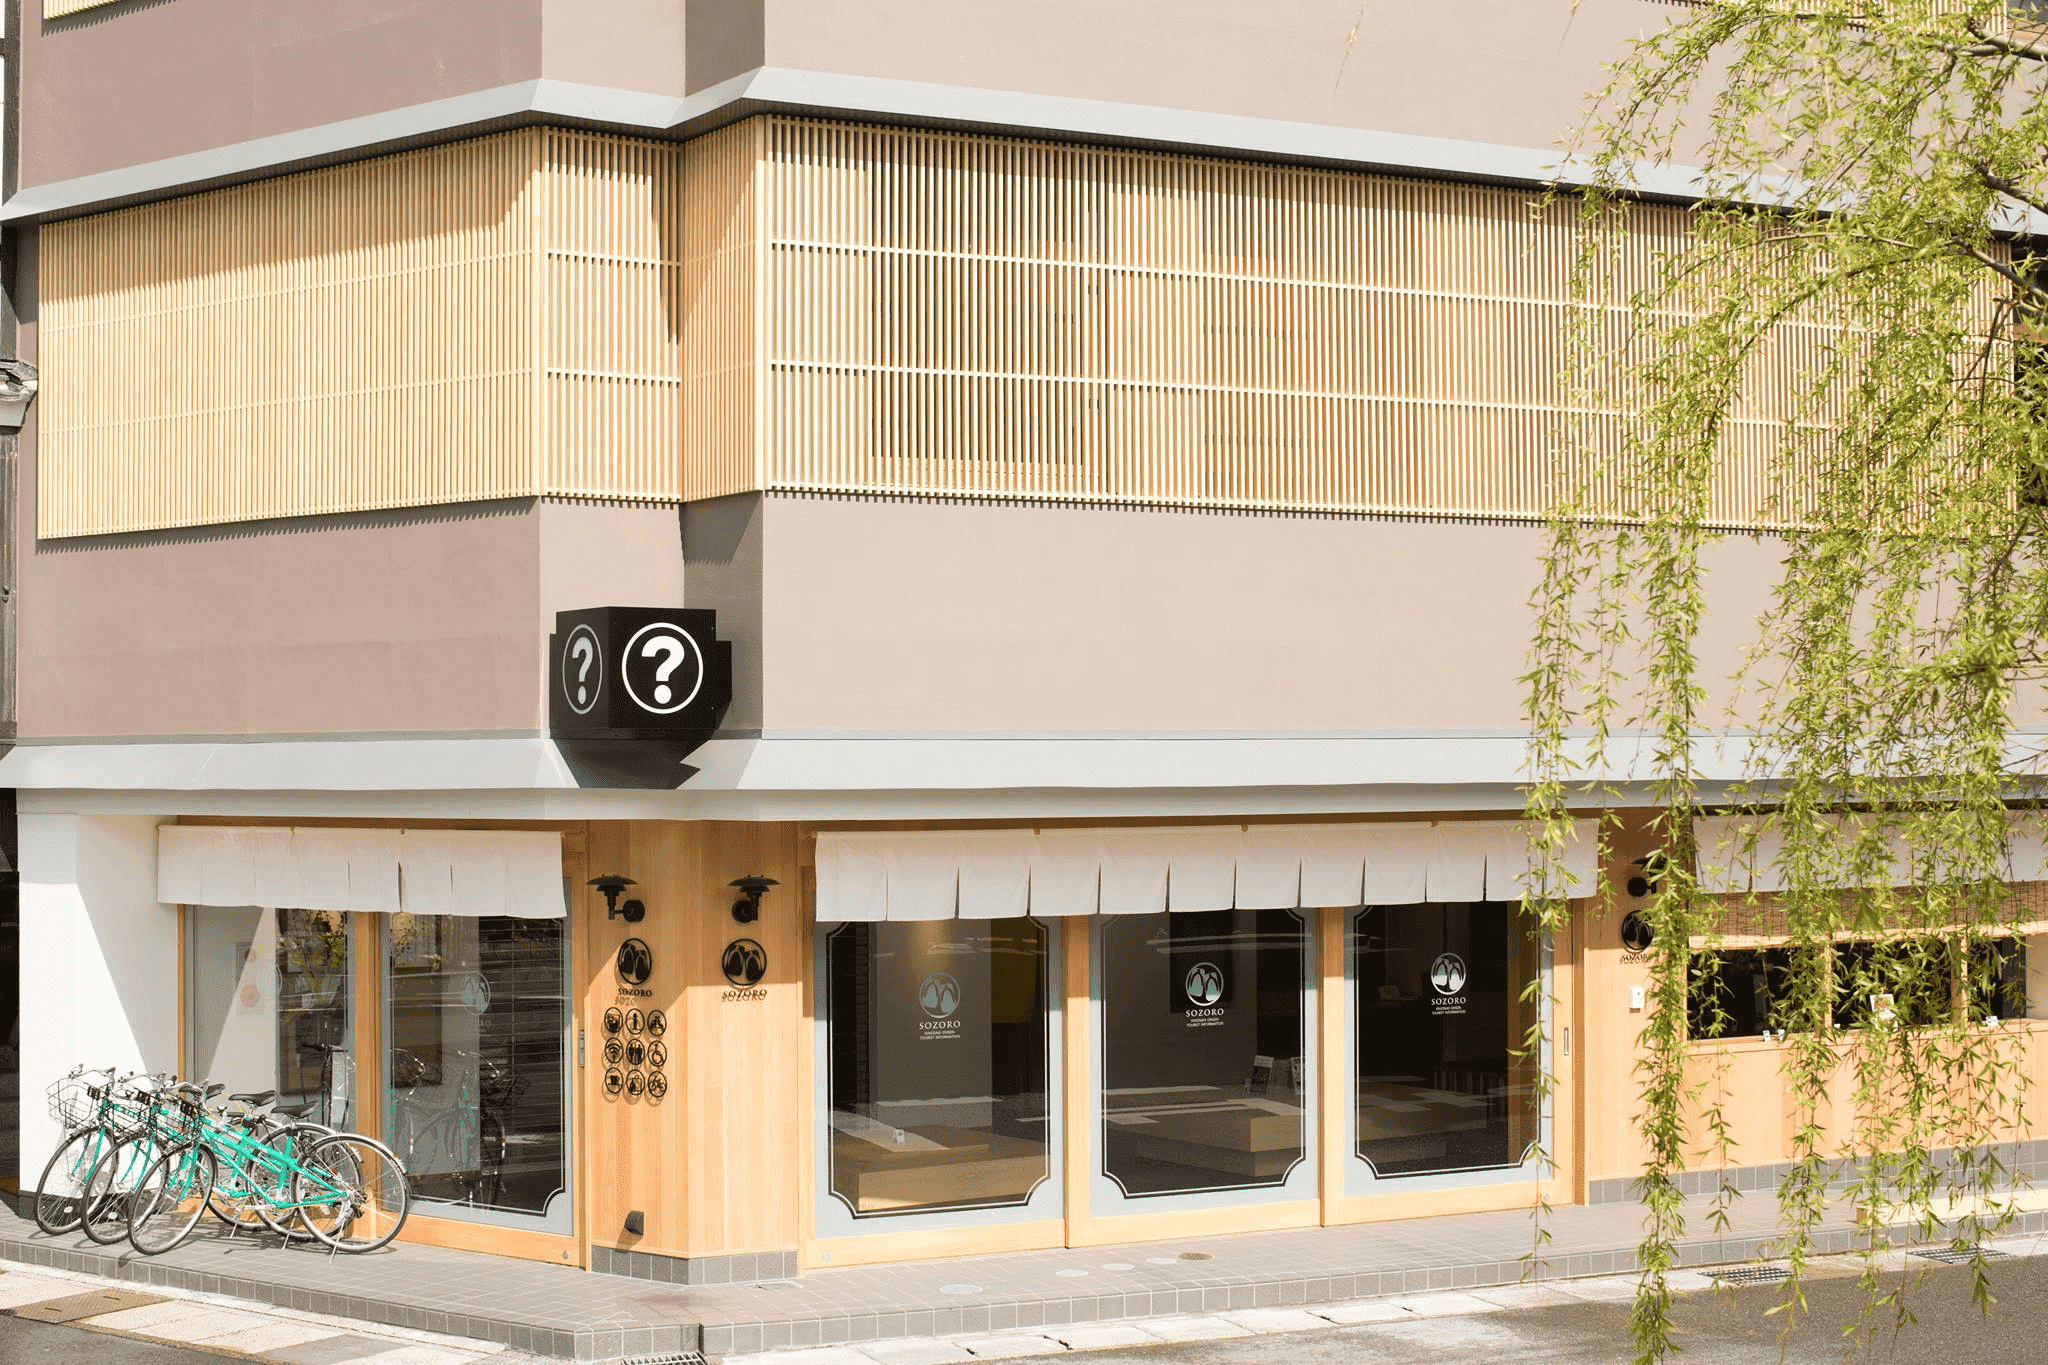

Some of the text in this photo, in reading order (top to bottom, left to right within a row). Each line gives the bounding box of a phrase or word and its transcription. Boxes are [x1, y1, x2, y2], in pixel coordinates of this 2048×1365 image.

[641, 635, 685, 705] ?
[617, 987, 653, 997] SOZORO
[722, 988, 768, 999] SOZORO
[1431, 997, 1466, 1005] SOZORO
[1185, 1008, 1224, 1017] SOZORO
[919, 1020, 960, 1029] SOZORO
